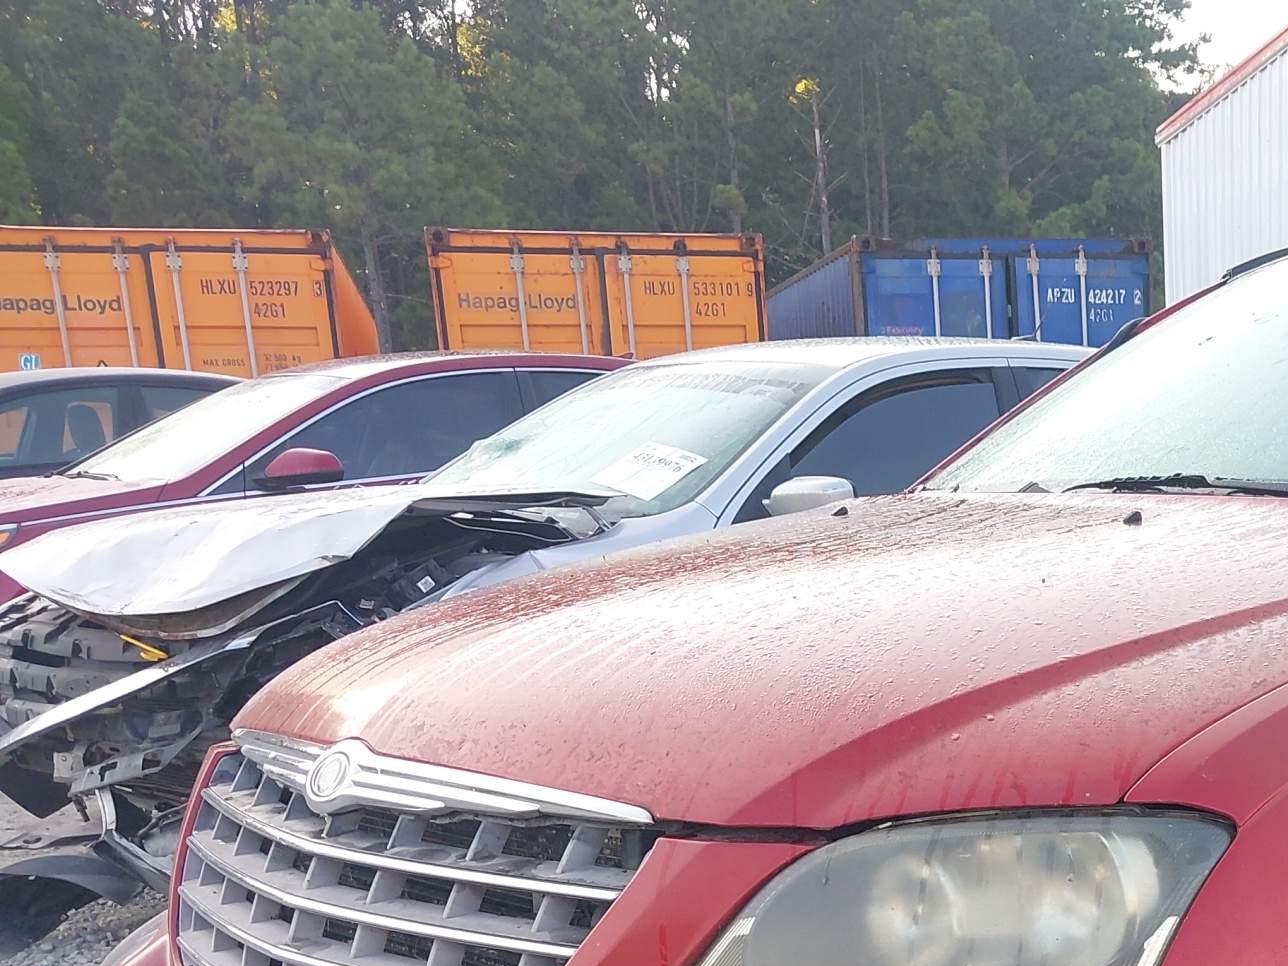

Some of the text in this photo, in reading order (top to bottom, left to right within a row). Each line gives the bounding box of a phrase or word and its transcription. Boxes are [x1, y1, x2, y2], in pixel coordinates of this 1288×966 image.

[201, 279, 236, 295] HLXU
[249, 280, 298, 296] 523297
[643, 281, 754, 297] HLXU 533101 9
[1047, 287, 1142, 305] APZU 424217 2
[254, 303, 286, 318] 42G1
[695, 302, 726, 317] 42G1
